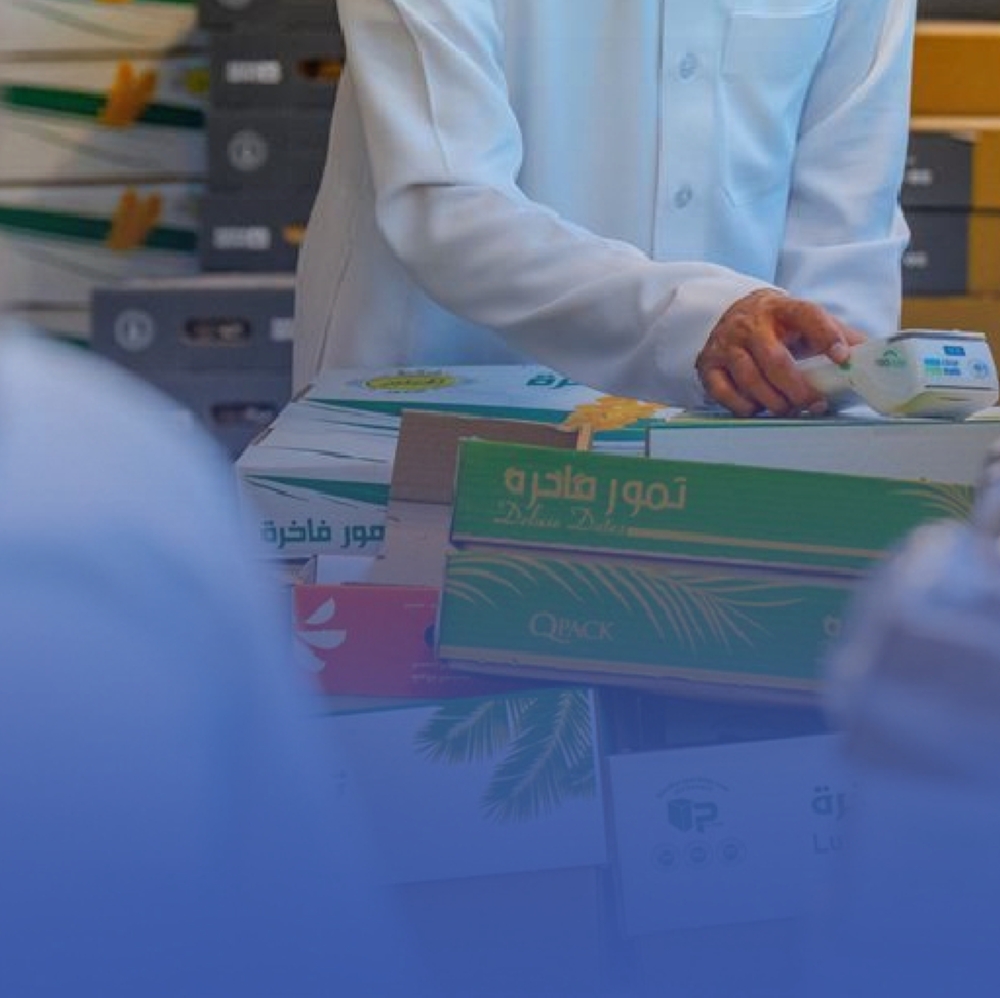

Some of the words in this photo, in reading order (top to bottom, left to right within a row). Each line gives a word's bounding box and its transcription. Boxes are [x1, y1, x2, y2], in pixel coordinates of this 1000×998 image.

[606, 476, 687, 517] تمور
[260, 517, 332, 549] فاخرة
[340, 524, 386, 549] مور
[528, 610, 614, 644] QPACK
